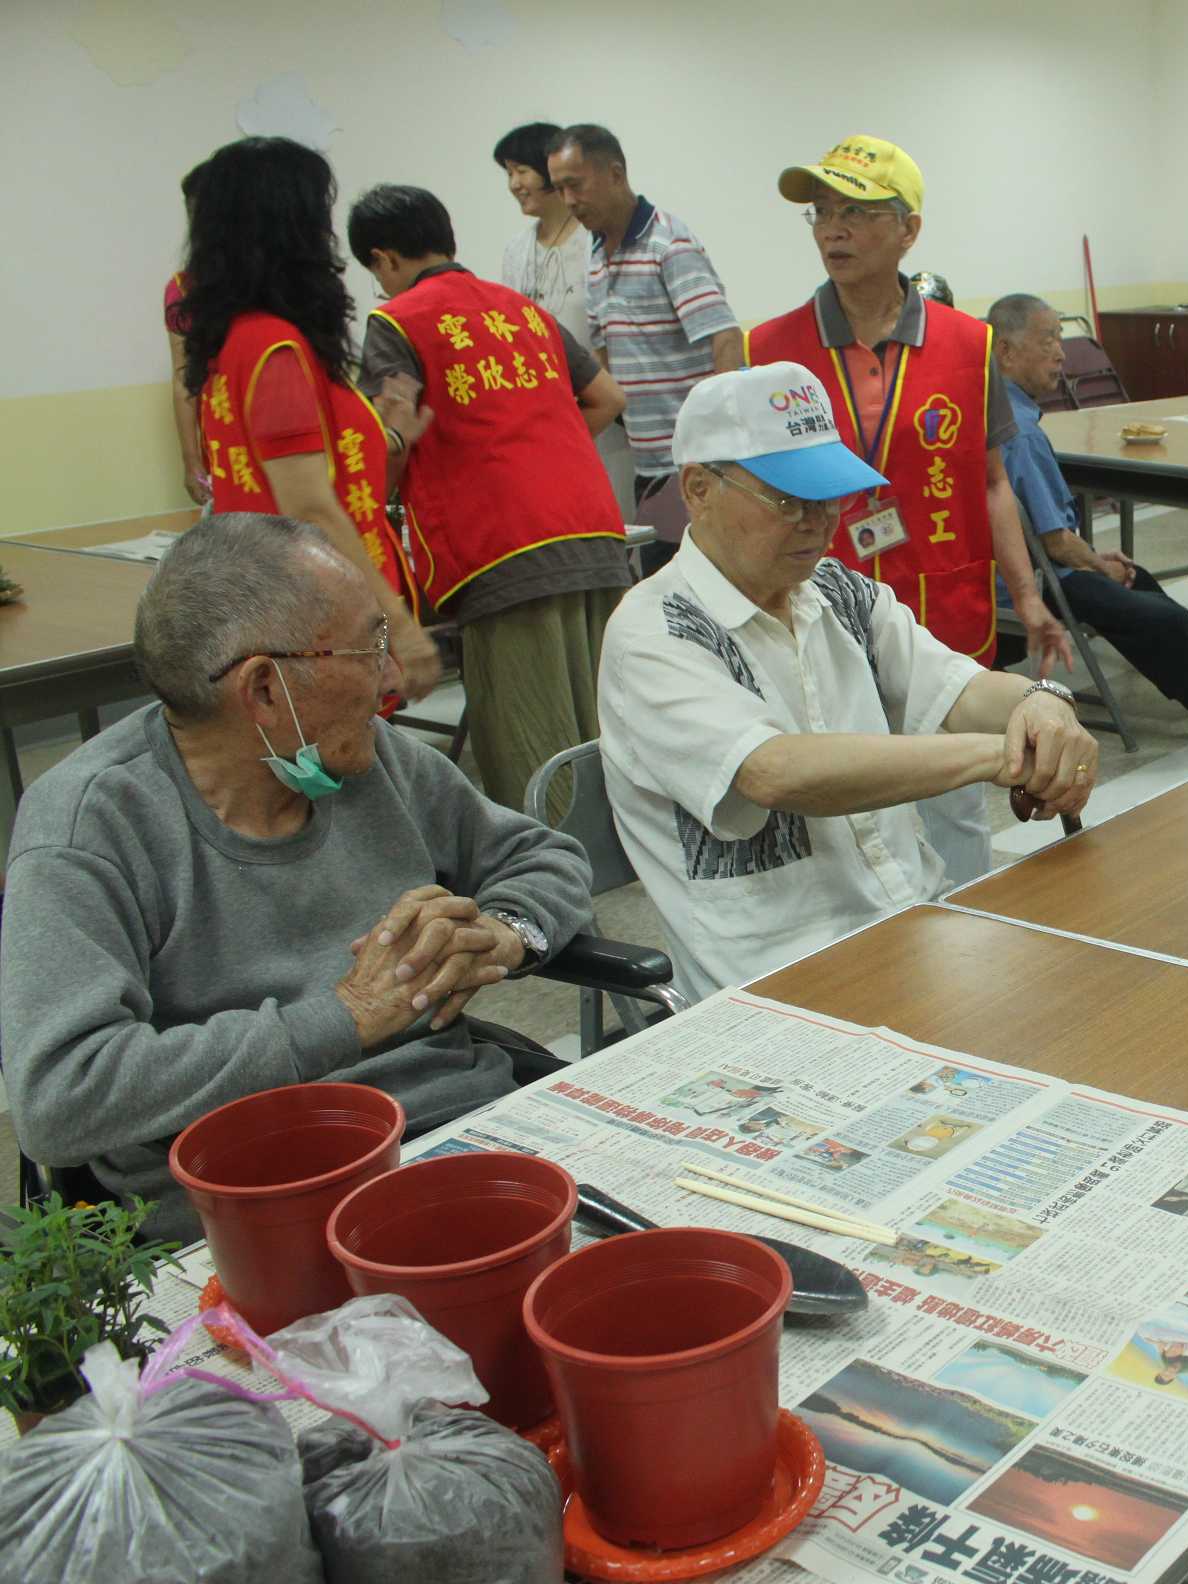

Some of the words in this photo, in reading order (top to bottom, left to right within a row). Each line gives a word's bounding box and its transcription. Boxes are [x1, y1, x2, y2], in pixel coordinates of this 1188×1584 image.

[437, 305, 549, 350] 雲林縣
[444, 351, 560, 406] 榮欣志工
[922, 455, 957, 544] 志工
